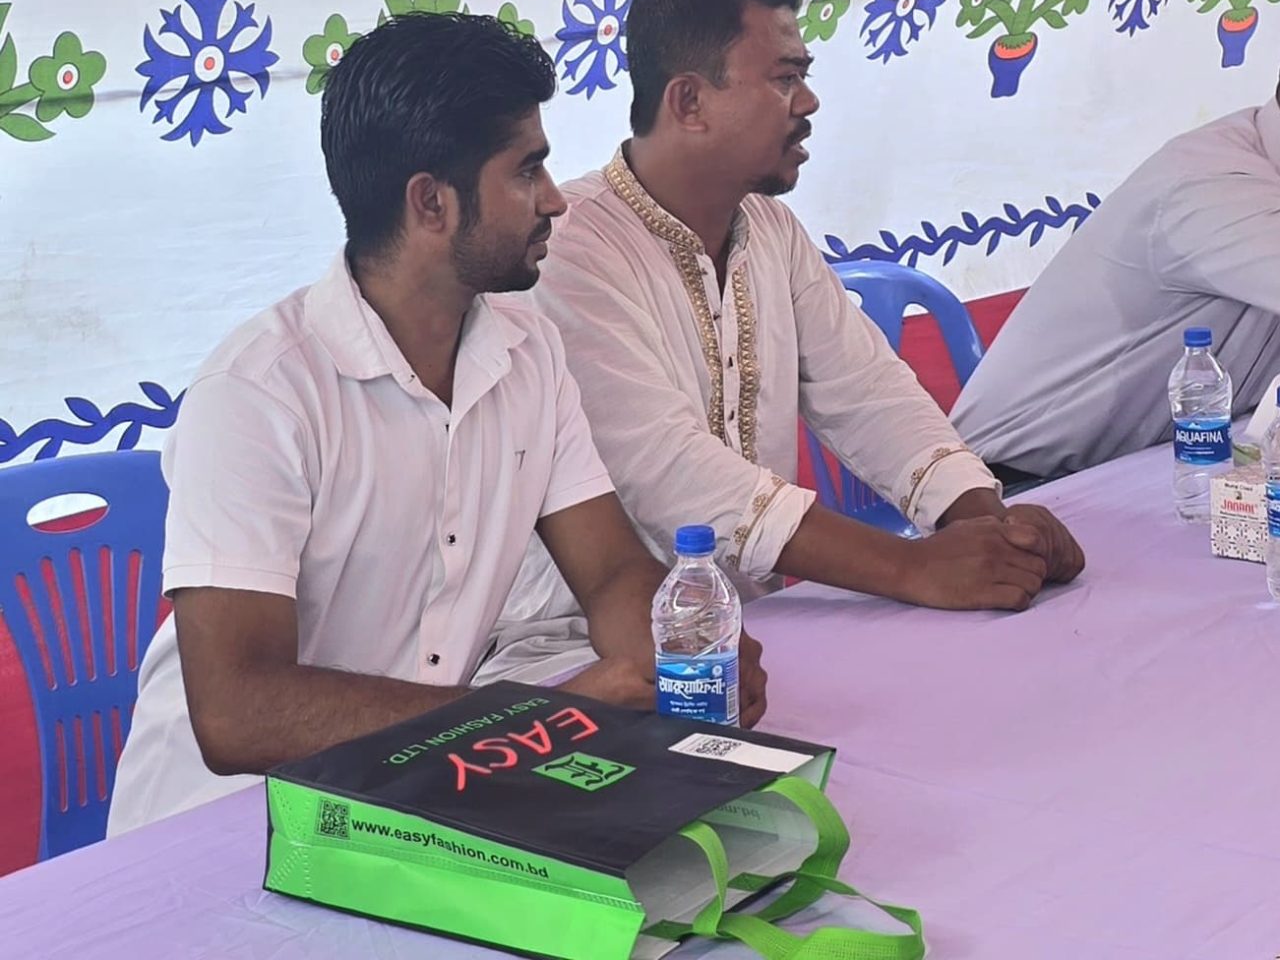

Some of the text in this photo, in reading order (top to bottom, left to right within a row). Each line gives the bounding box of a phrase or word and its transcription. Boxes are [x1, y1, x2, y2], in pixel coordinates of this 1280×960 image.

[1175, 429, 1224, 445] AQUAFINA
[382, 697, 551, 765] EASY FASHION LTD.
[447, 707, 599, 791] EASY
[351, 818, 549, 879] www.easyfashion.com.bd
